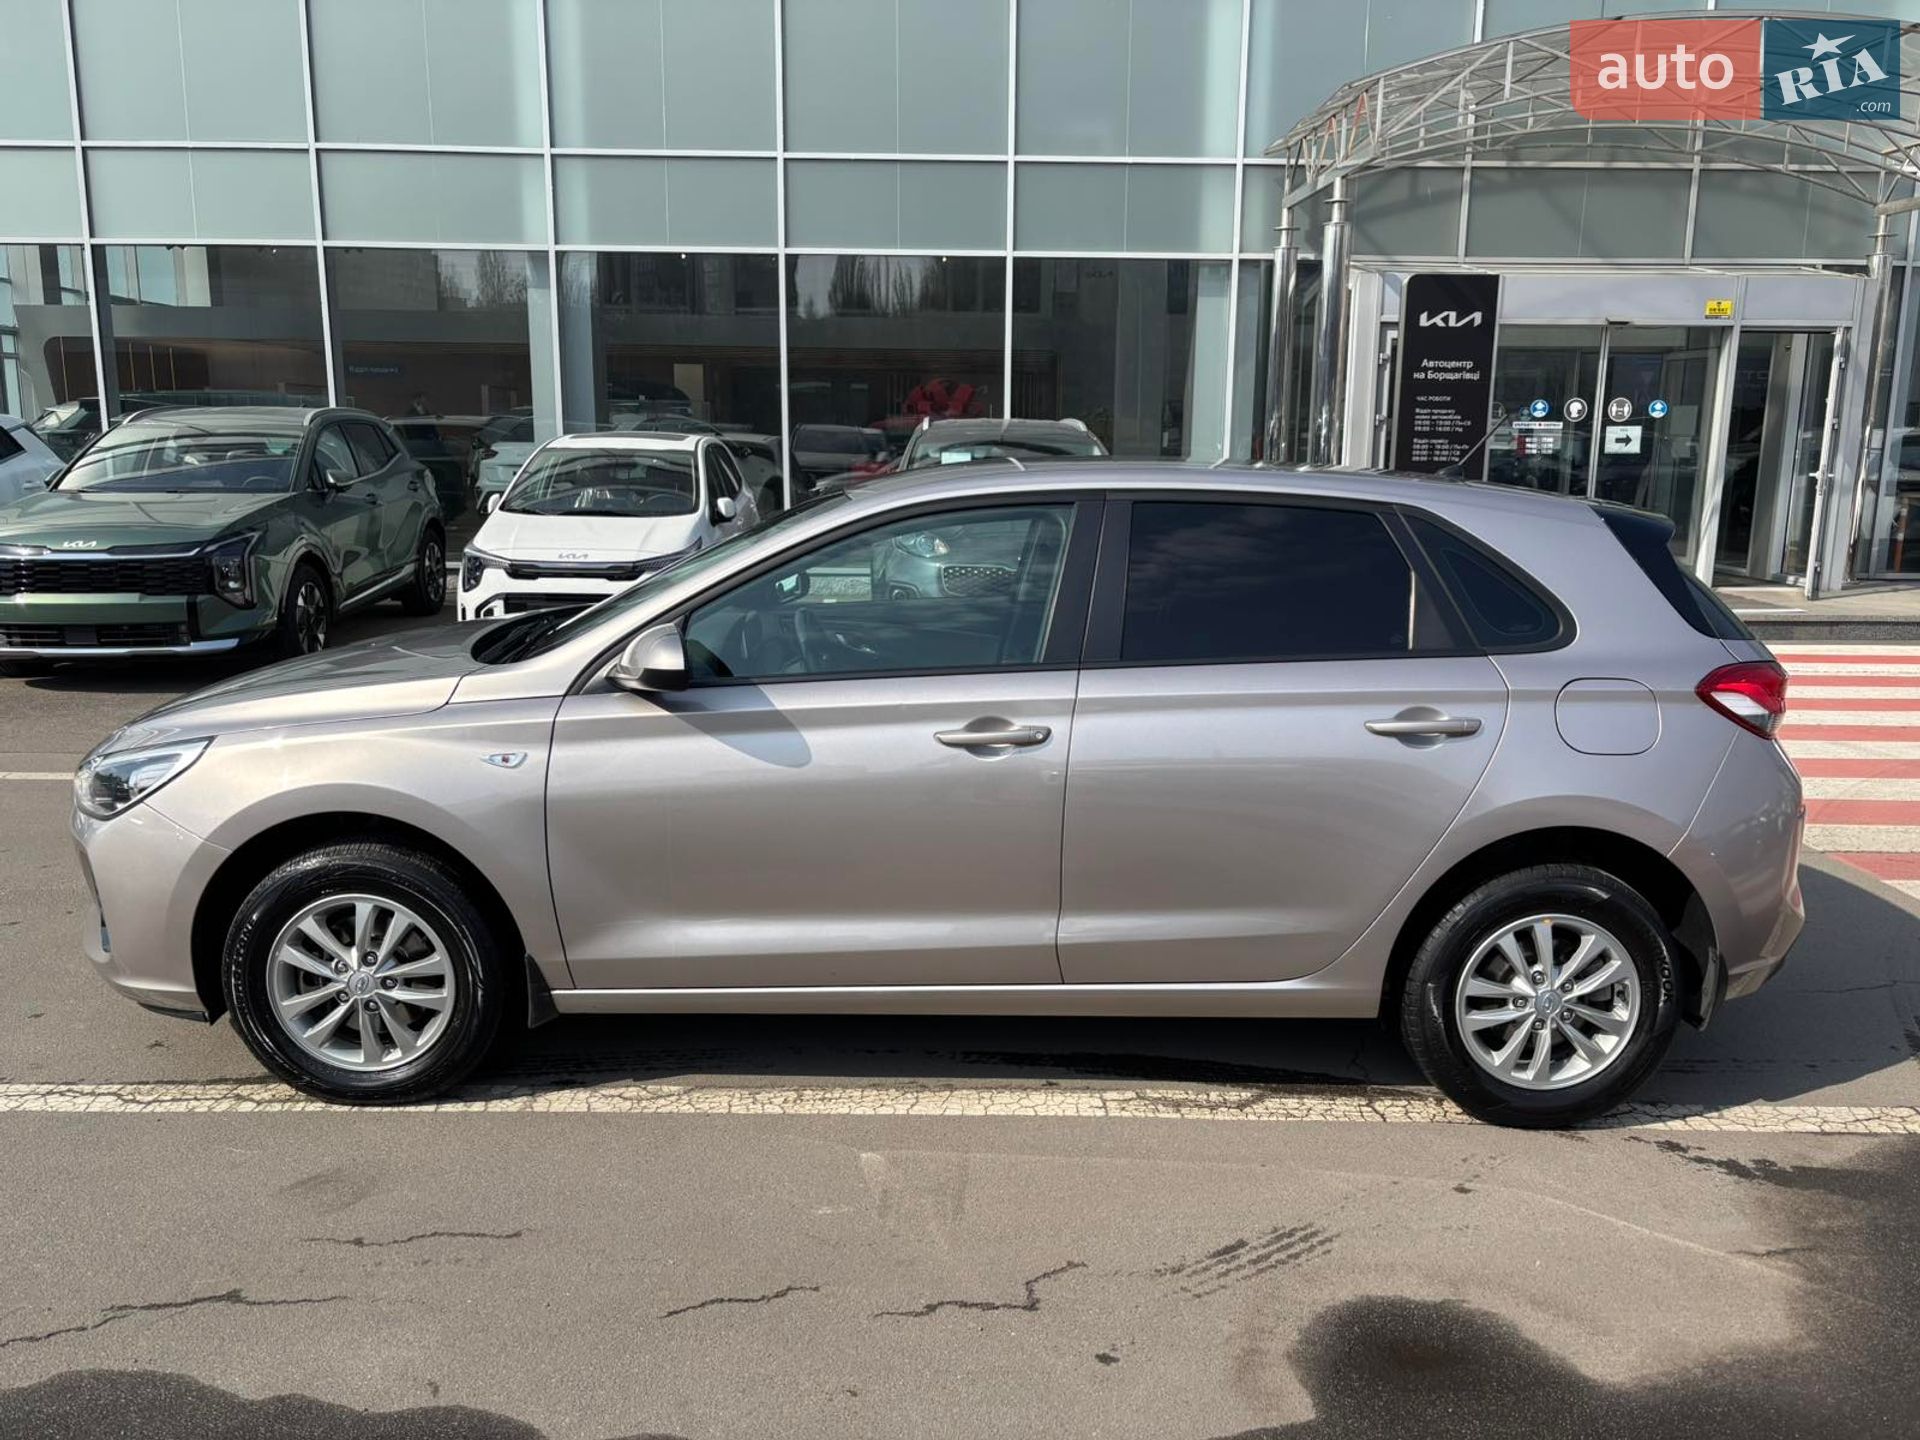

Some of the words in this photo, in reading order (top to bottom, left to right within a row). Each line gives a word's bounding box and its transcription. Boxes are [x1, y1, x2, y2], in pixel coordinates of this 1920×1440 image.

[1419, 310, 1482, 327] KIA
[1421, 358, 1473, 370] Автоцентр
[1413, 371, 1425, 379] на
[1427, 370, 1480, 381] Борщагівці
